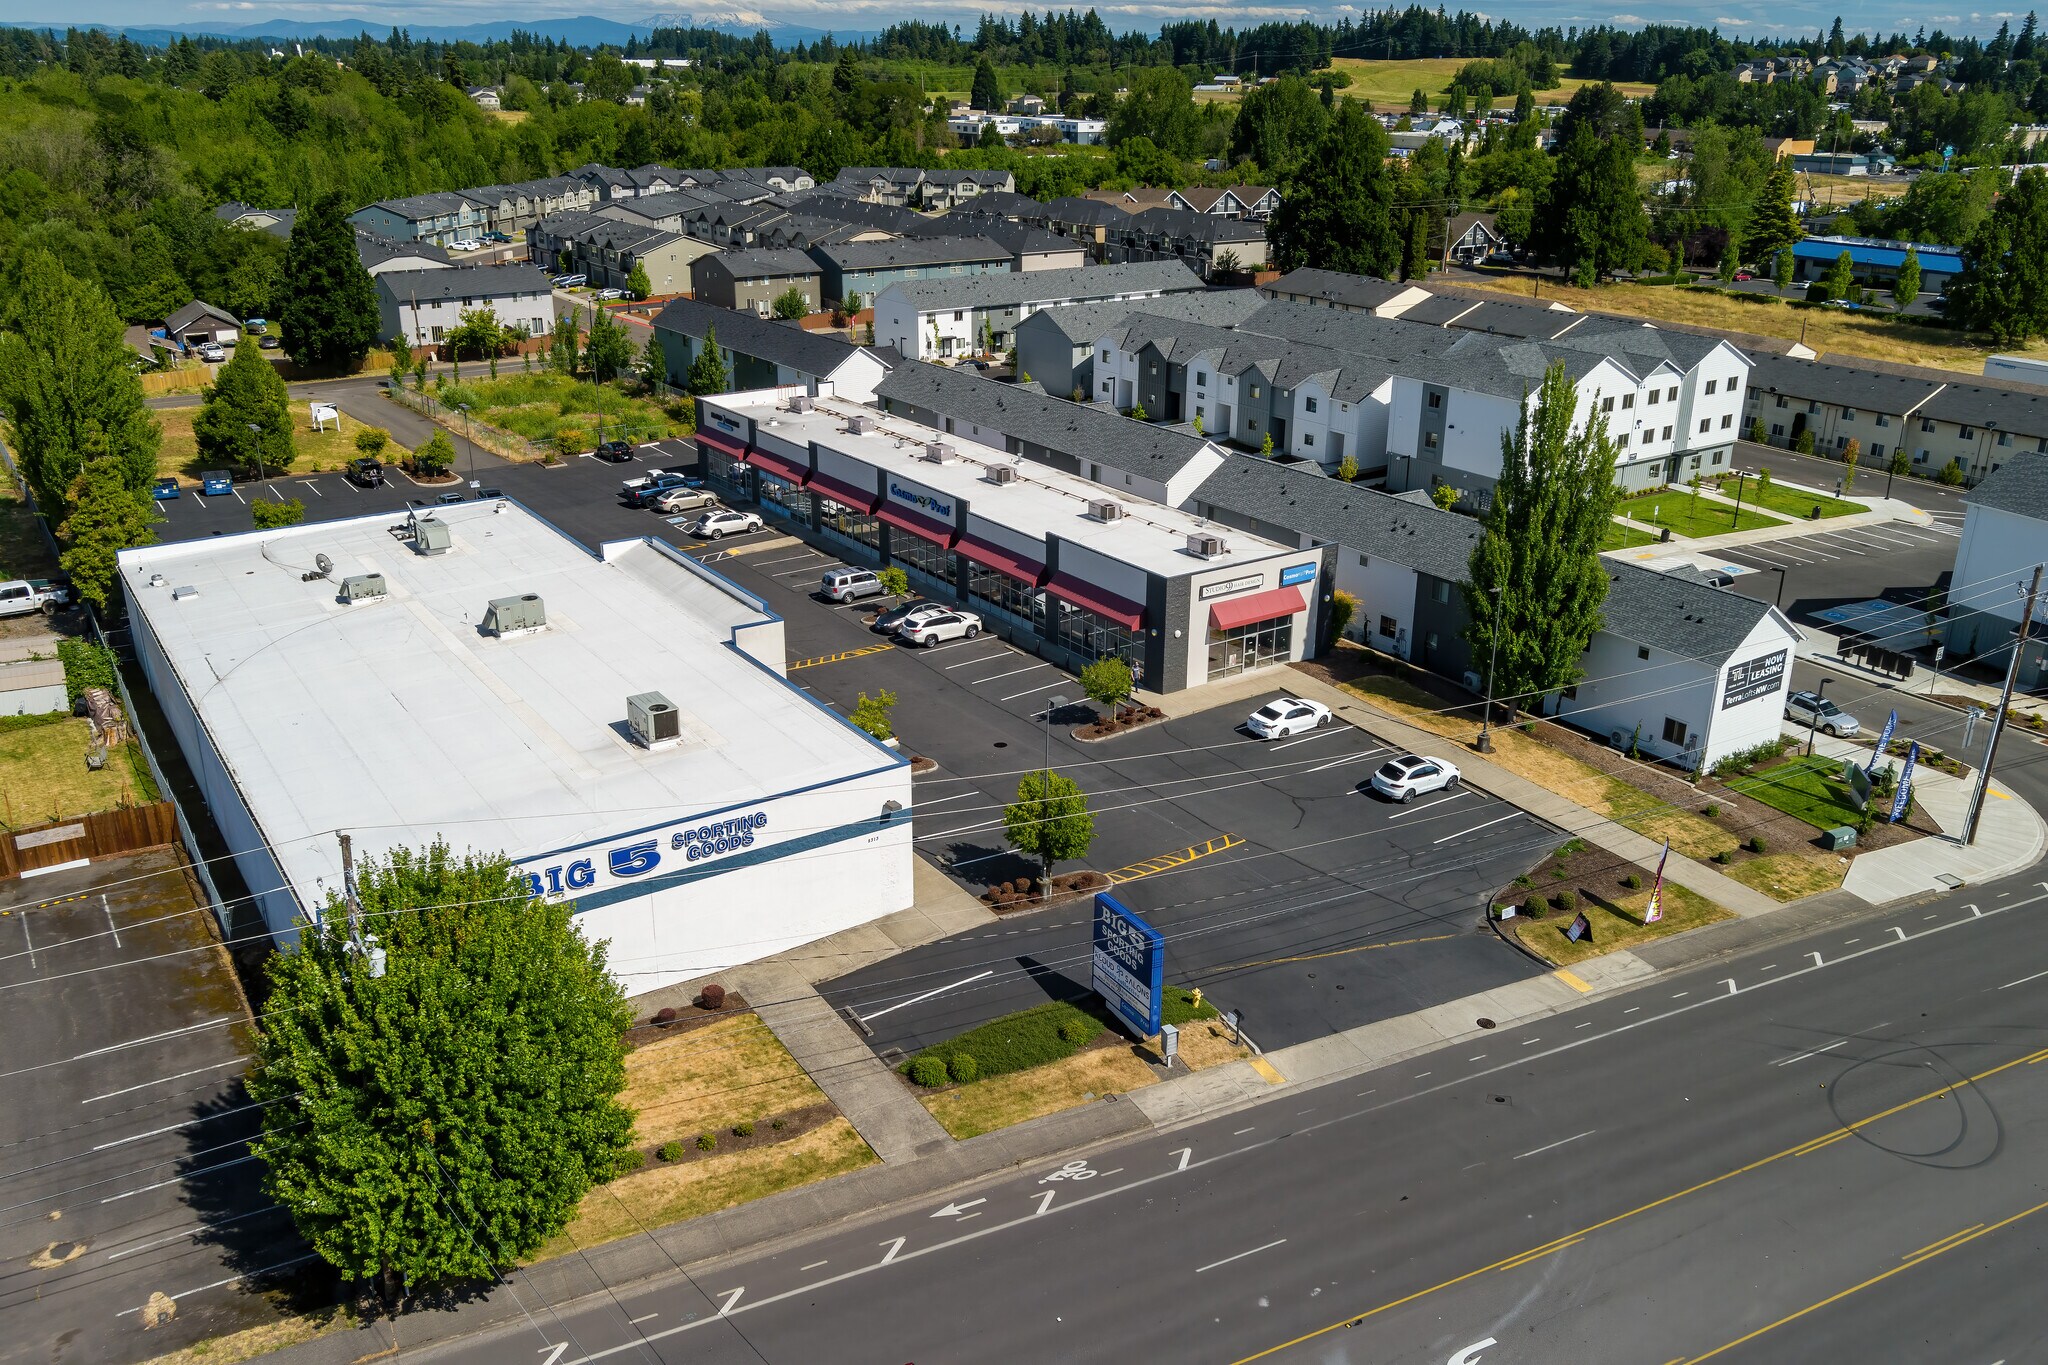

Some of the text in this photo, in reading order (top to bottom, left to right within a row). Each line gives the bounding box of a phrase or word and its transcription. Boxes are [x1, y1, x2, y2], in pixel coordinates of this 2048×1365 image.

[890, 483, 951, 517] Cosmo Prof
[1751, 663, 1783, 681] LEASING
[1765, 653, 1785, 667] NOW
[1726, 681, 1780, 705] TerraLoftsNW.com
[671, 812, 768, 850] SPORTING
[686, 831, 755, 862] GOODS
[522, 839, 662, 900] BIG 5
[1102, 906, 1145, 951] BIG 5
[1102, 925, 1144, 965] SPORTING
[1107, 941, 1137, 970] GOODS
[1124, 975, 1150, 1000] SALONS
